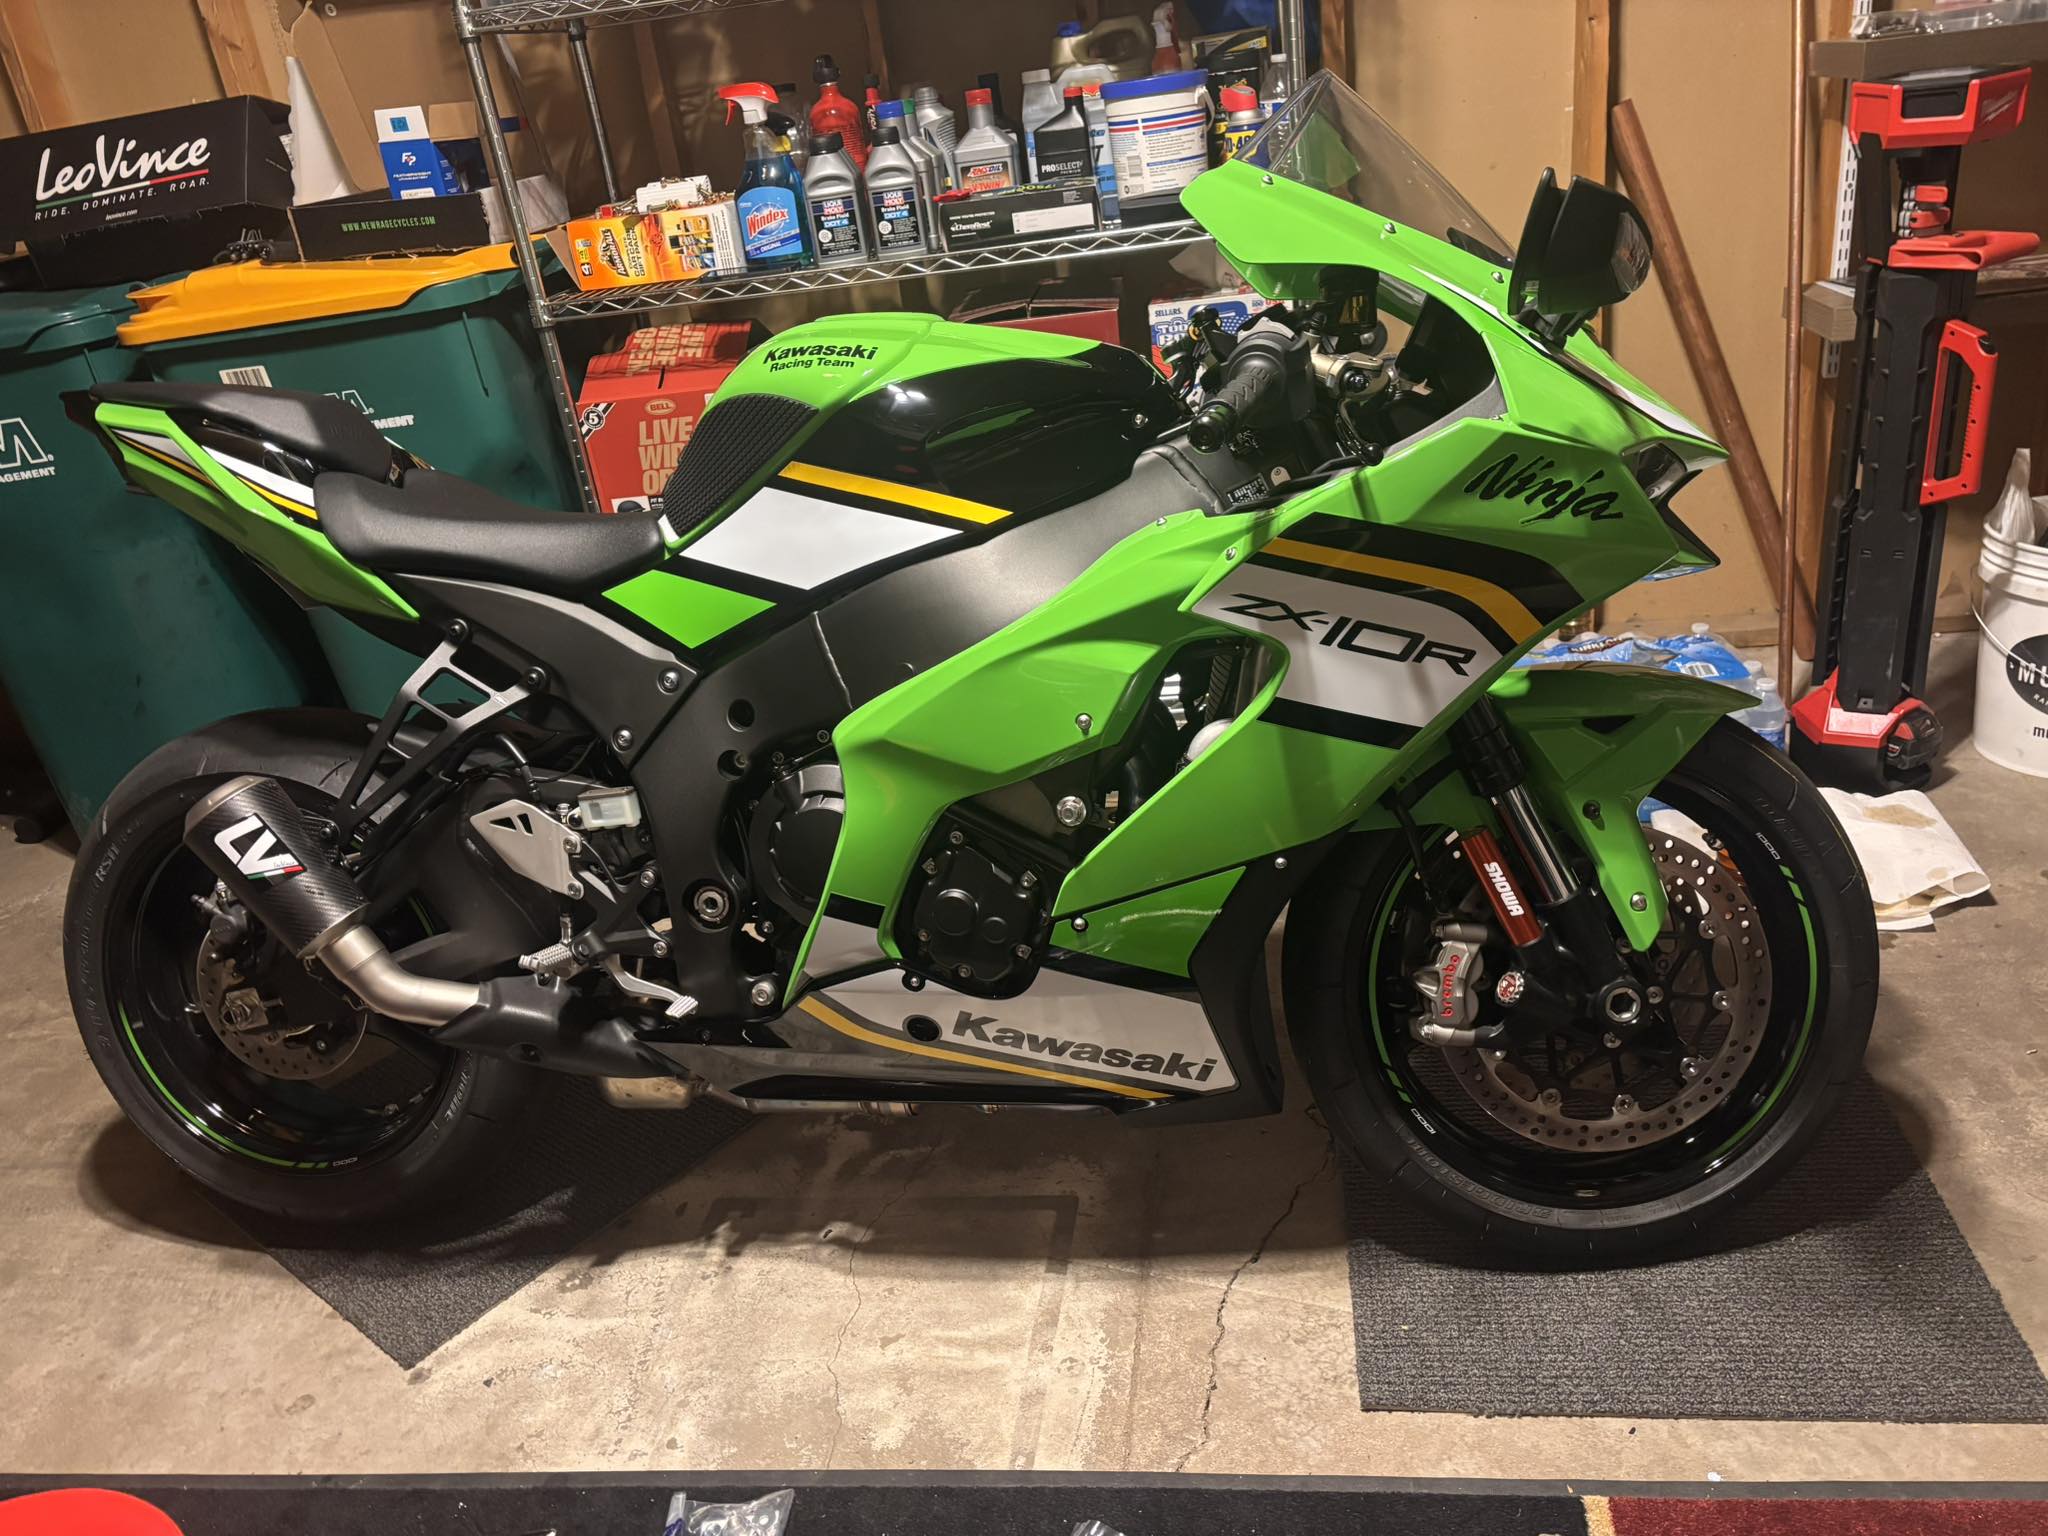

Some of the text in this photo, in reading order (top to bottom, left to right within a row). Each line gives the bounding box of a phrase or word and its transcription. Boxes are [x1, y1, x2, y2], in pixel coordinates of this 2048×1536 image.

[867, 104, 877, 130] LUCA
[36, 134, 210, 201] LeoVince
[969, 164, 1003, 177] AMSOIL
[1041, 160, 1081, 173] PROSELECT
[34, 178, 209, 221] RIDE. DOMINATE. ROAR.
[340, 215, 436, 232] WWW.NEWRAGECYCLES.COM
[746, 207, 789, 240] Windex
[763, 344, 878, 365] Kawasaki
[769, 357, 855, 373] Racing Team
[589, 412, 600, 424] 5
[650, 403, 671, 411] BELL
[371, 414, 414, 430] MENT
[638, 416, 694, 446] LIVE
[638, 442, 685, 471] WID
[642, 469, 674, 496] OP
[1463, 452, 1623, 525] Ninja
[1220, 592, 1477, 677] ZX-10R
[1483, 861, 1525, 917] SHOWA
[1440, 954, 1461, 1019] brembo
[951, 1010, 1217, 1083] Kawasaki
